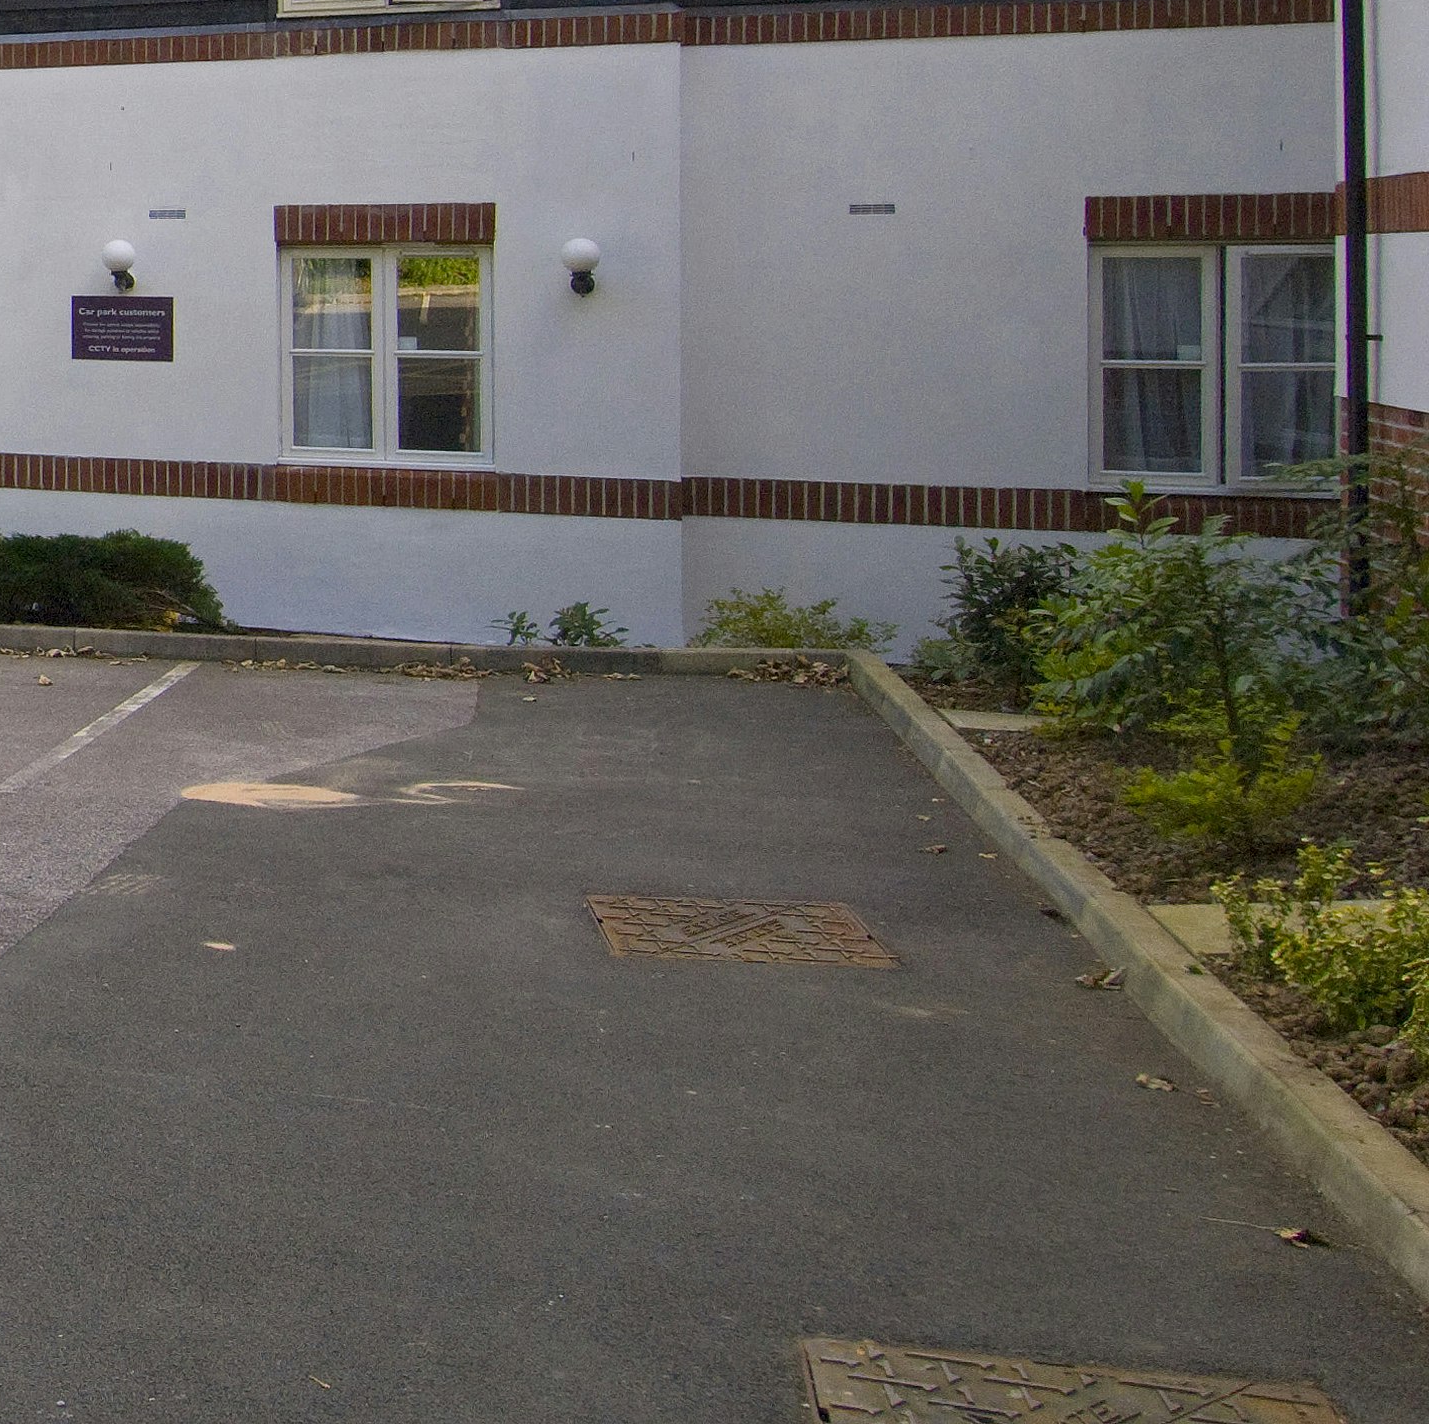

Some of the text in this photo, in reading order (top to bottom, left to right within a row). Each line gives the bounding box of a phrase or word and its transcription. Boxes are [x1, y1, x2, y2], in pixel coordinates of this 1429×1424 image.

[78, 307, 166, 317] Car park customers
